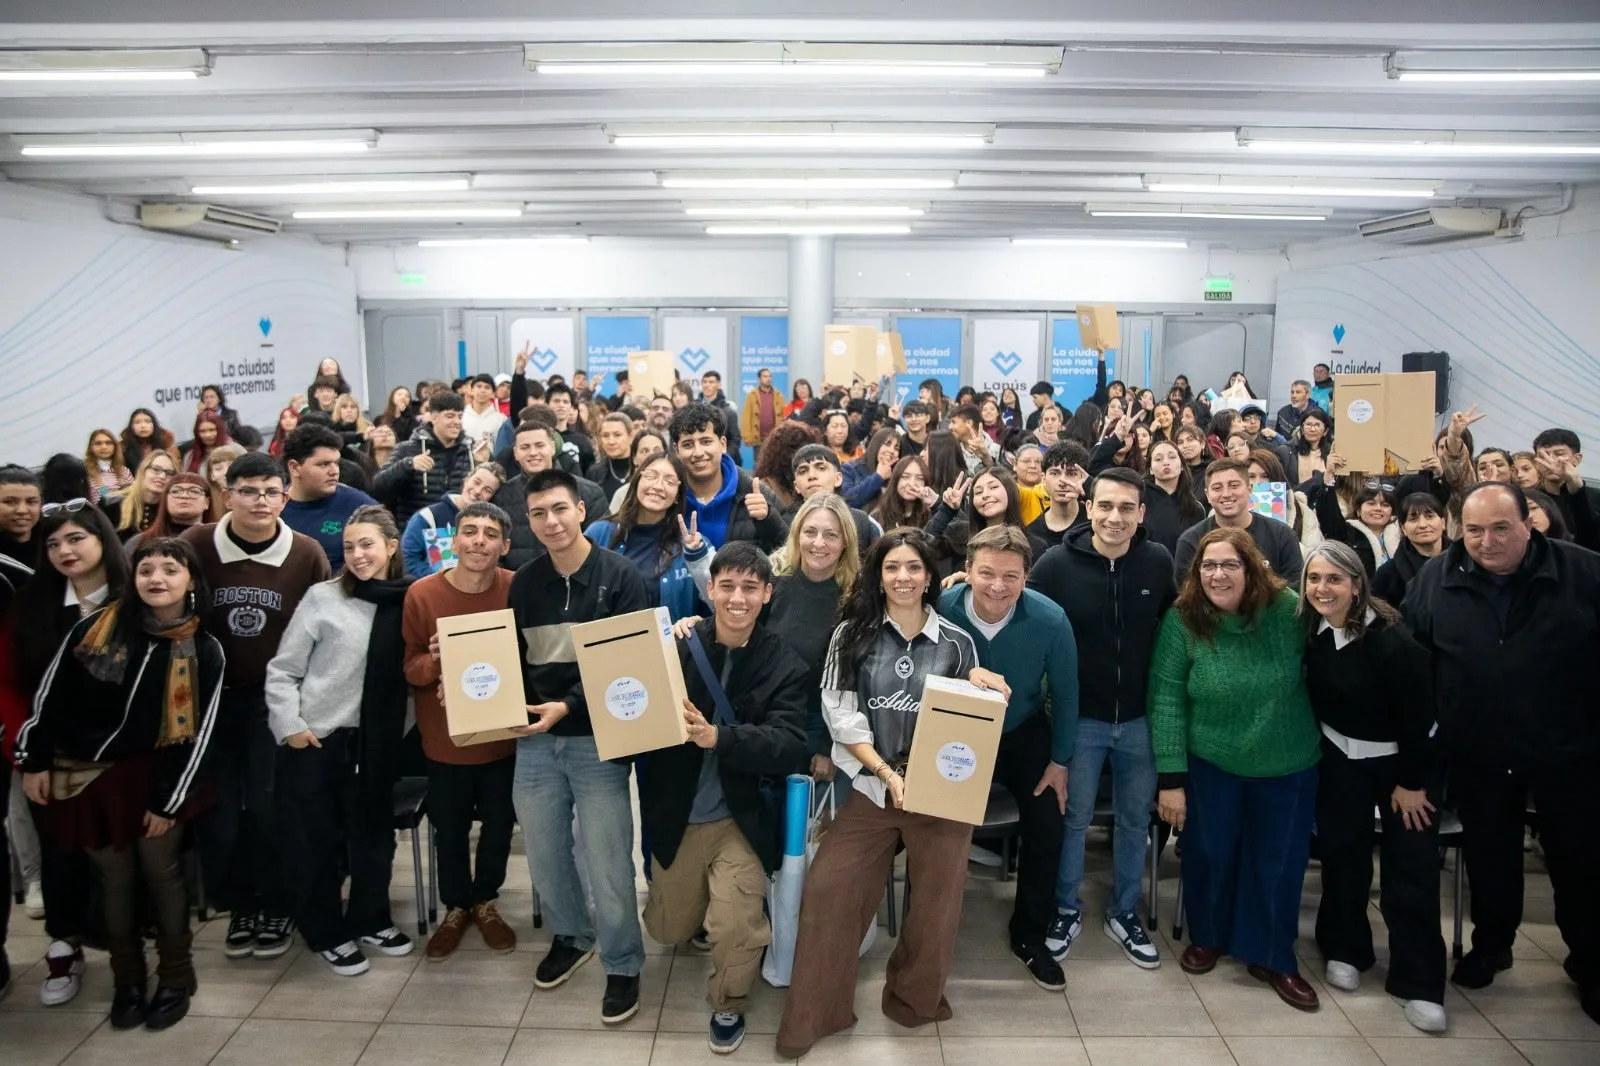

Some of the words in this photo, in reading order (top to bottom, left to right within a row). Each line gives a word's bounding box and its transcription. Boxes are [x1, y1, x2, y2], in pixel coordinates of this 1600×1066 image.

[588, 345, 603, 354] La
[741, 345, 755, 354] La
[757, 345, 788, 354] ciuda
[913, 347, 950, 357] ciudad
[1053, 347, 1067, 357] La
[1068, 347, 1098, 357] ciuda
[919, 358, 938, 366] nos
[1052, 358, 1073, 367] que
[1074, 358, 1094, 366] nos
[220, 361, 235, 377] La
[238, 358, 275, 376] ciudad
[906, 367, 959, 375] erecemos
[222, 379, 276, 396] erecemos
[983, 380, 1027, 391] Lanús
[155, 386, 181, 407] que
[184, 385, 204, 400] no
[213, 586, 282, 611] BOSTON
